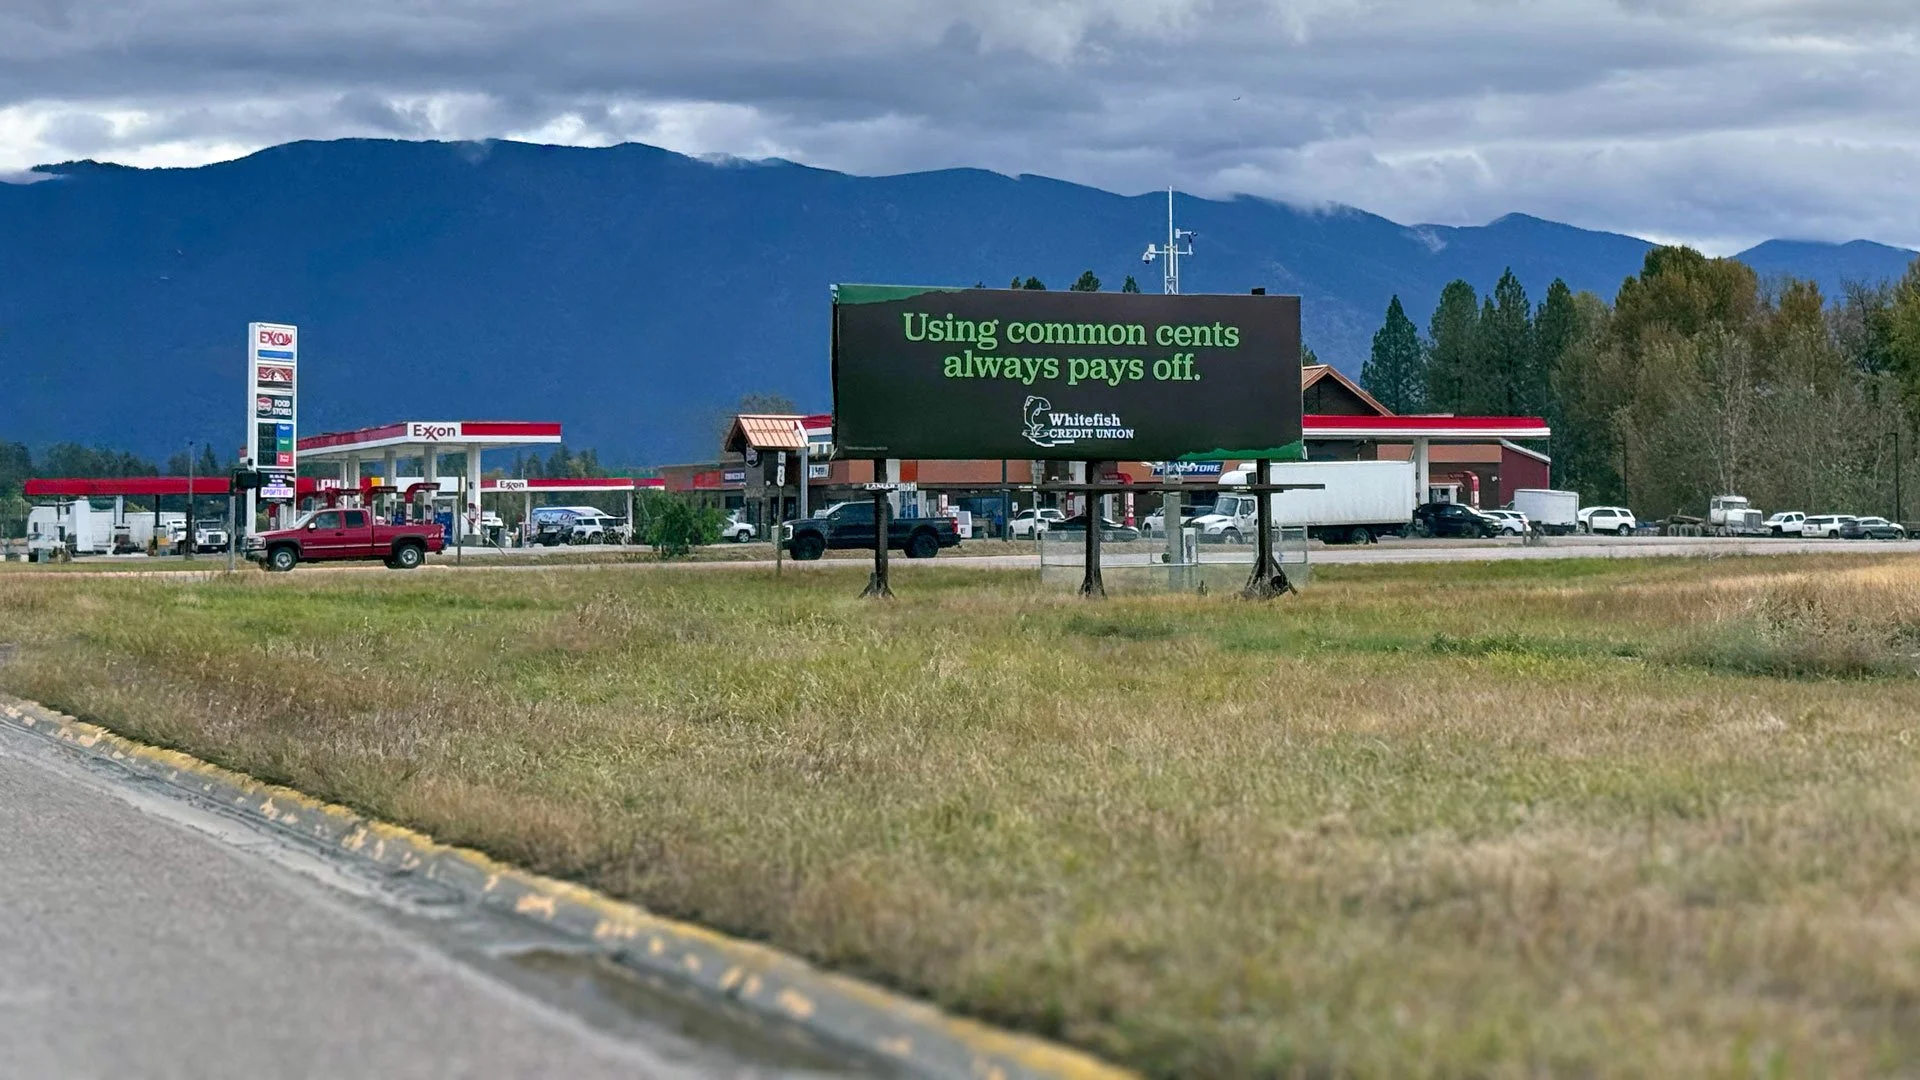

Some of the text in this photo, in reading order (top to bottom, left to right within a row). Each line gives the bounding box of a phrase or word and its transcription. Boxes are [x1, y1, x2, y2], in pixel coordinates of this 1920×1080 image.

[903, 313, 1240, 350] Using common cents
[944, 350, 1201, 386] always pays off.
[274, 399, 290, 407] FOOD
[272, 408, 292, 416] STORES
[1049, 413, 1121, 426] Whitefish
[413, 424, 456, 440] Exxon
[1049, 429, 1134, 439] CREDIT UNION
[500, 480, 525, 490] Exxon
[262, 488, 282, 496] SPORTS
